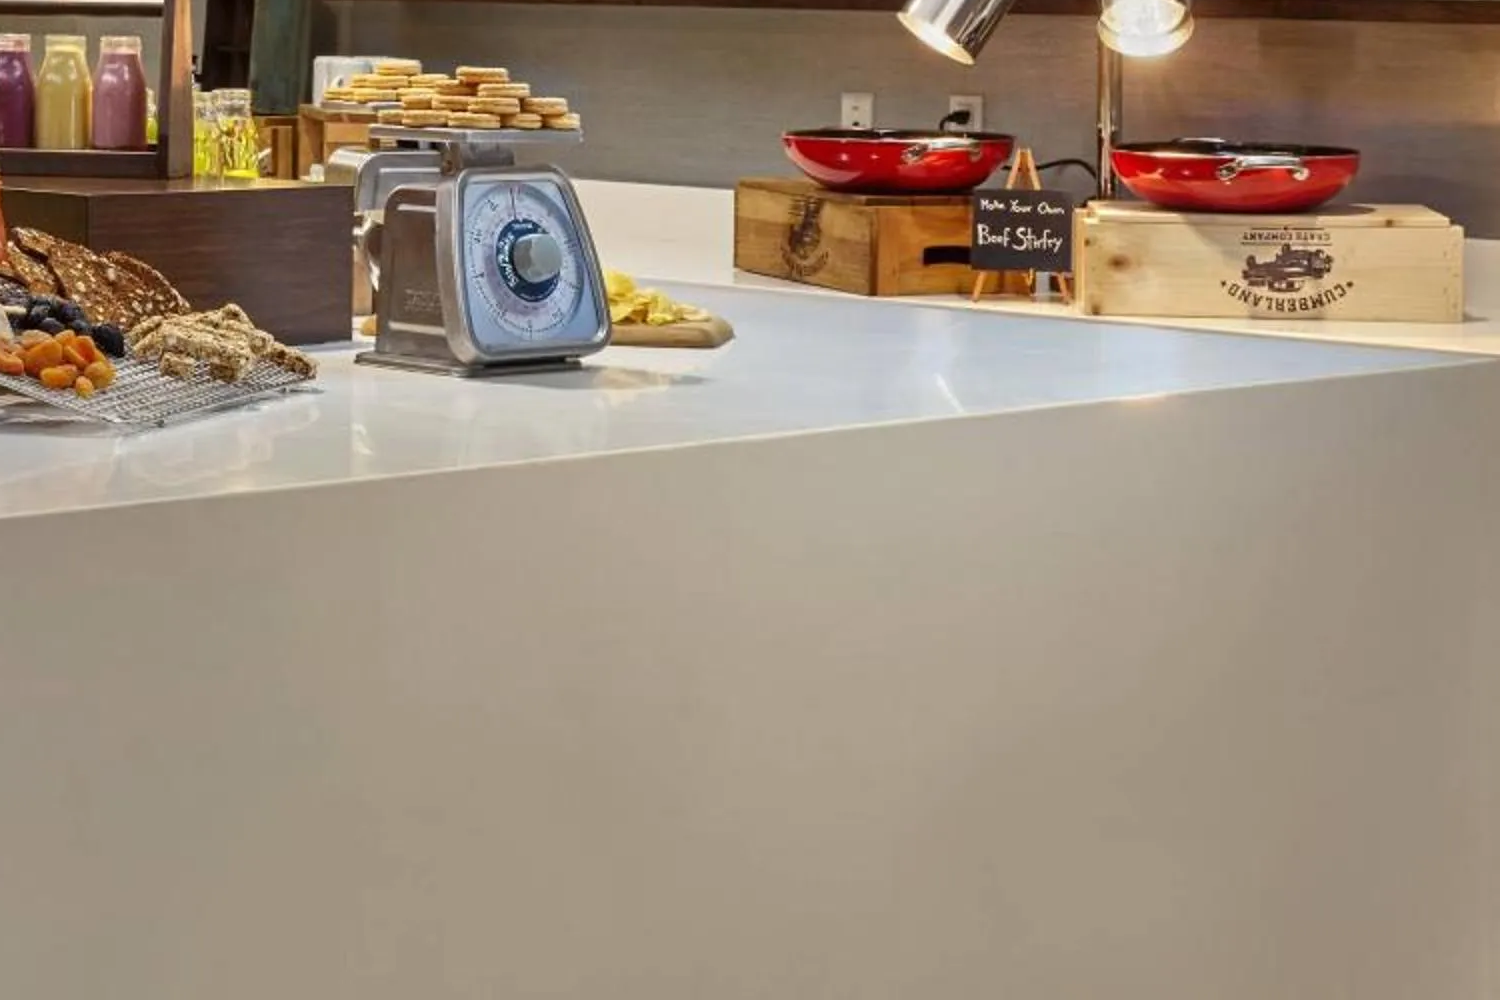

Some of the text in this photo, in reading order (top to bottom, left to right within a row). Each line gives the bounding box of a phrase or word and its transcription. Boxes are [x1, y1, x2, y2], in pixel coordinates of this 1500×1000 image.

[980, 198, 1066, 215] Make Your Own
[977, 223, 1011, 248] Beef
[1242, 231, 1332, 242] CRATE COMPANY
[1227, 283, 1348, 313] CUMBERLAND
